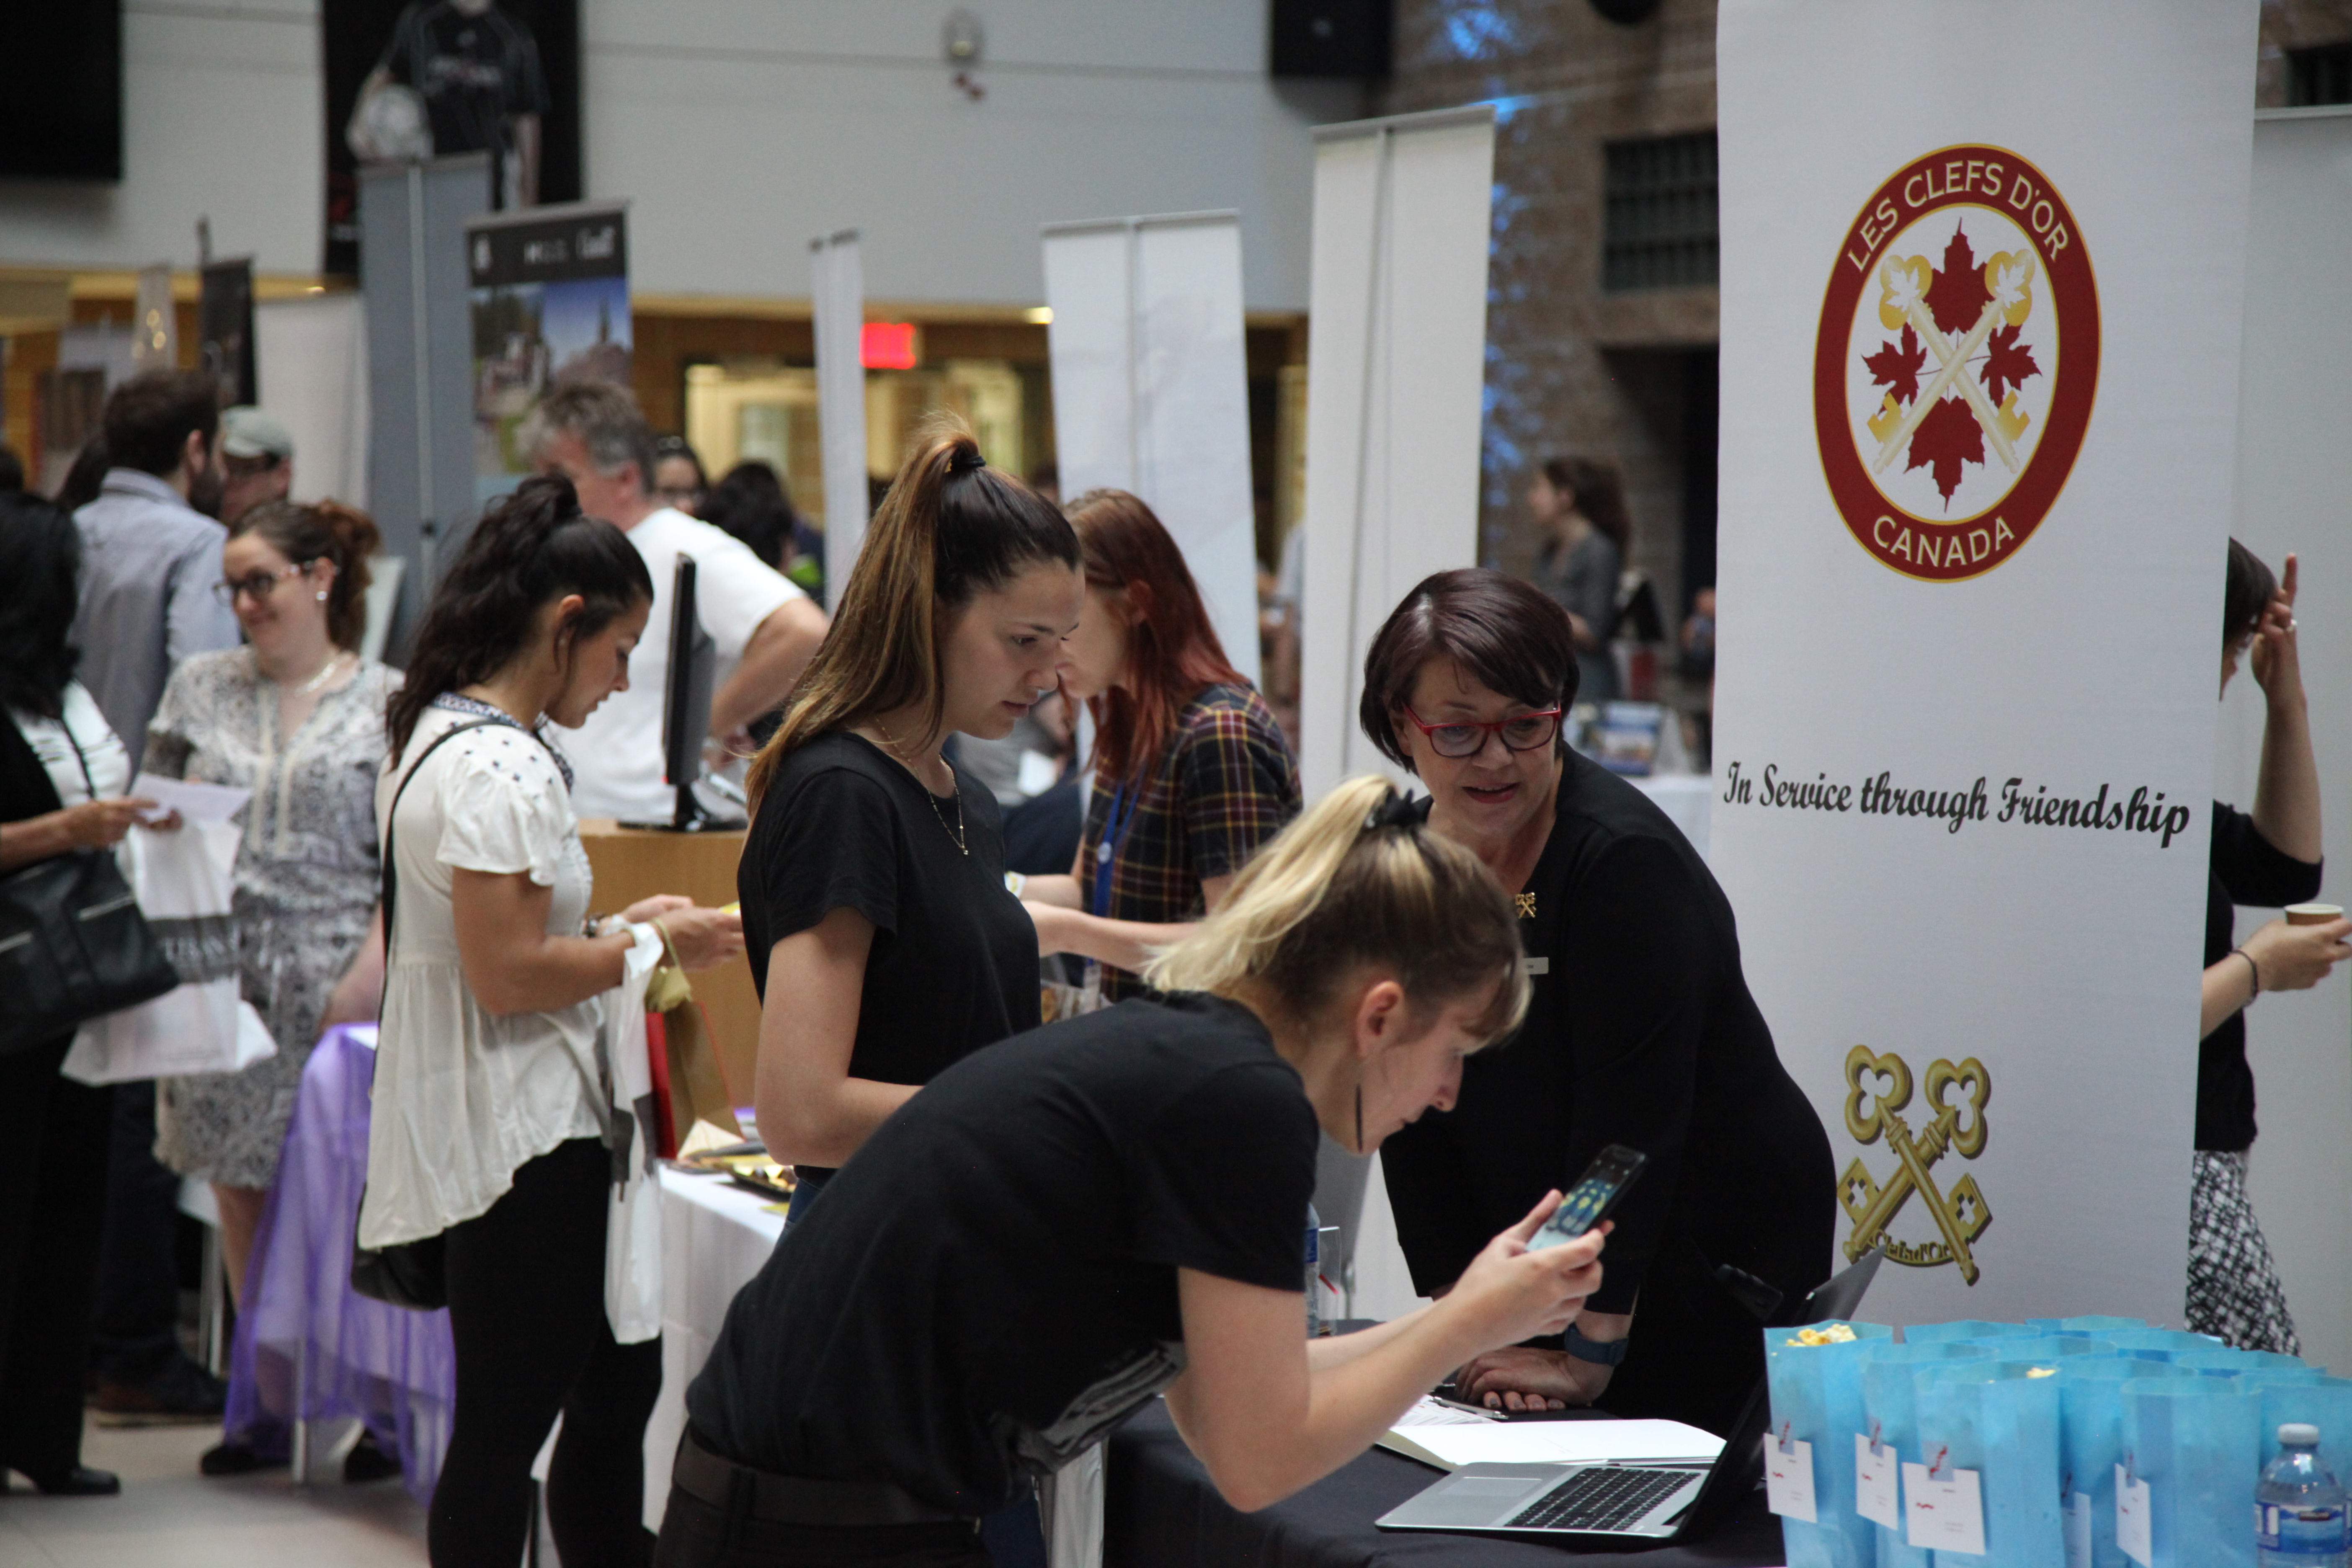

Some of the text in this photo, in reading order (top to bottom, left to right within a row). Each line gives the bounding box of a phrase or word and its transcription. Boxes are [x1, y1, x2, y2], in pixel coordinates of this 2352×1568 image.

[1847, 160, 2069, 272] LES CLEFS D'OR
[1873, 515, 2015, 567] CANADA
[1723, 761, 2190, 849] In Service through Friendship
